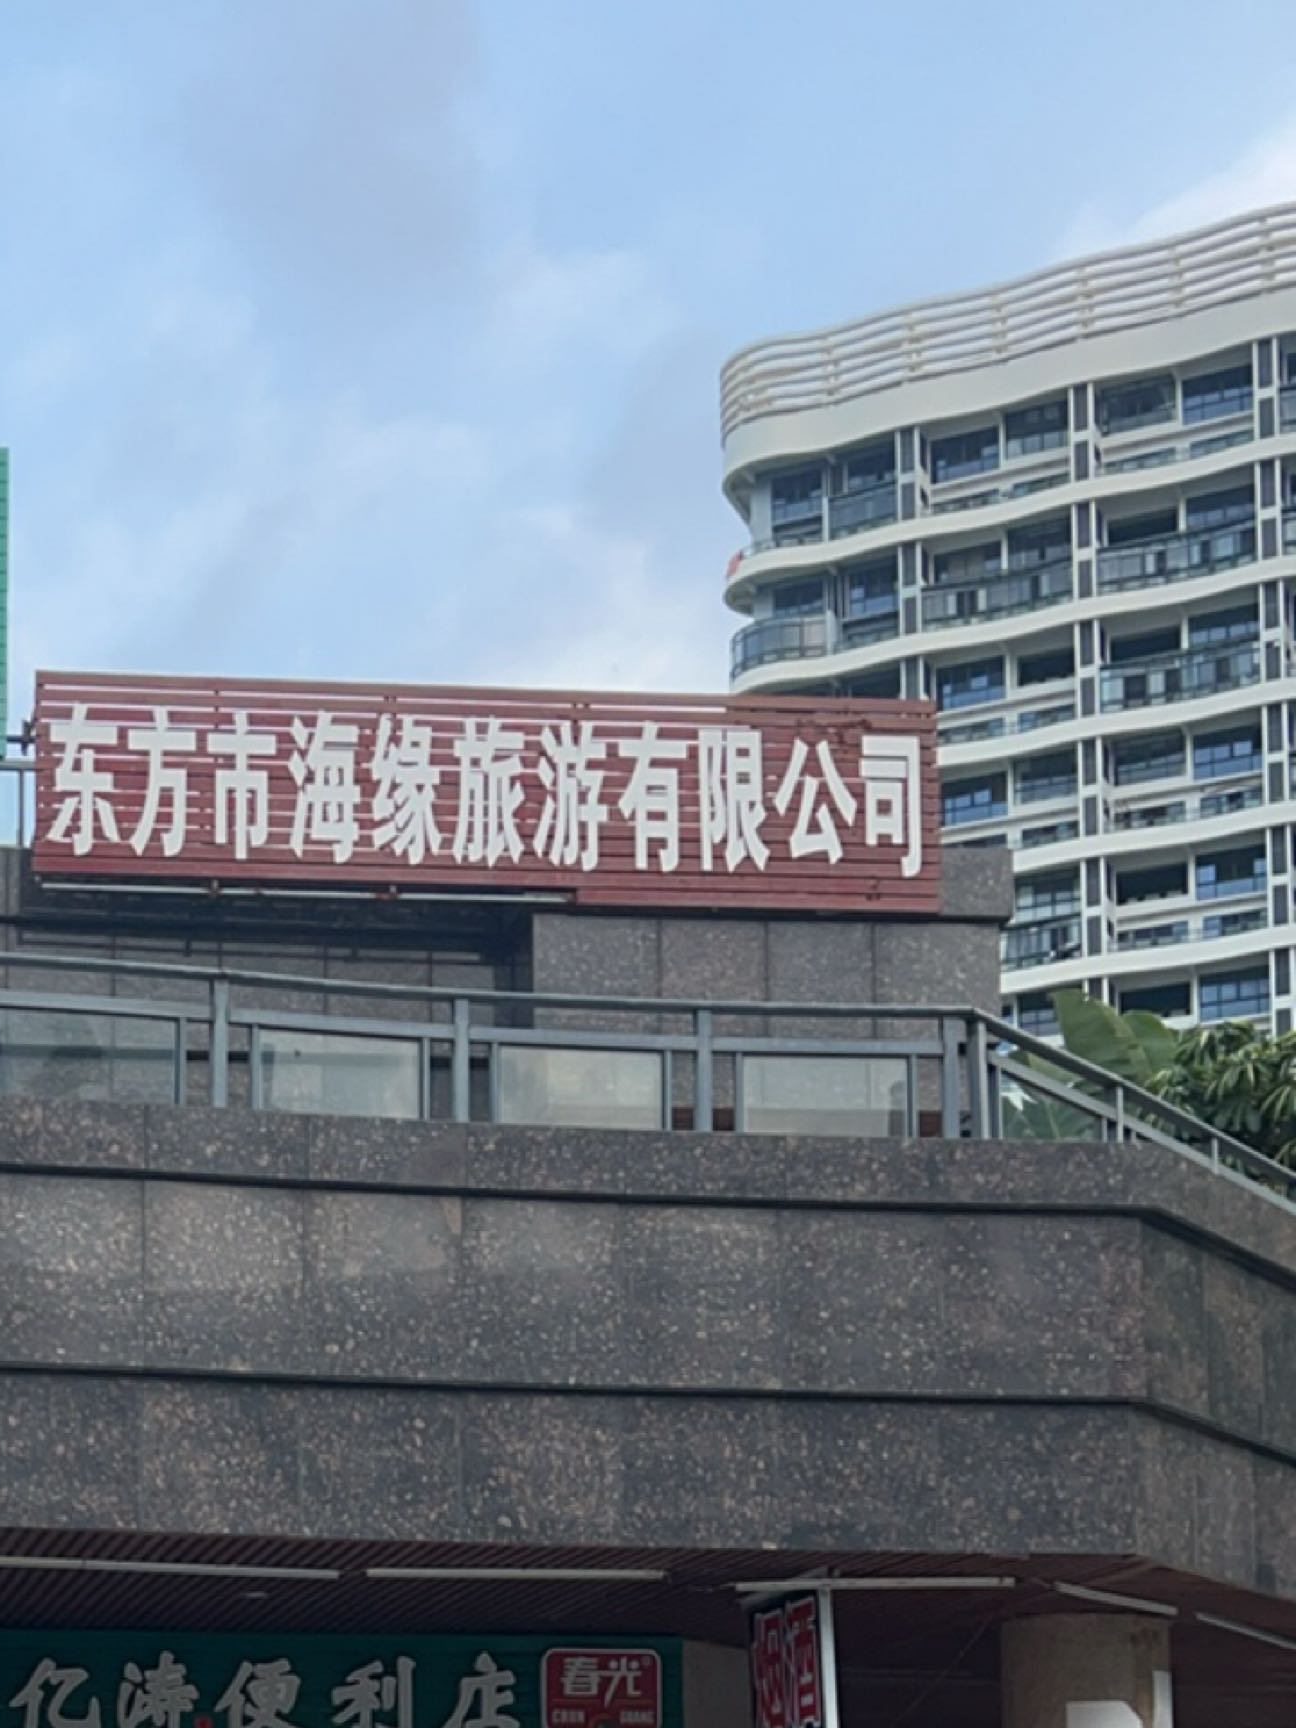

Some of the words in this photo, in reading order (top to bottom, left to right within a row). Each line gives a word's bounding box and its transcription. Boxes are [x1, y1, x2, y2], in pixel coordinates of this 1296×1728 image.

[46, 704, 924, 878] 东方市海缘旅游有限公司
[559, 1656, 643, 1708] 春光
